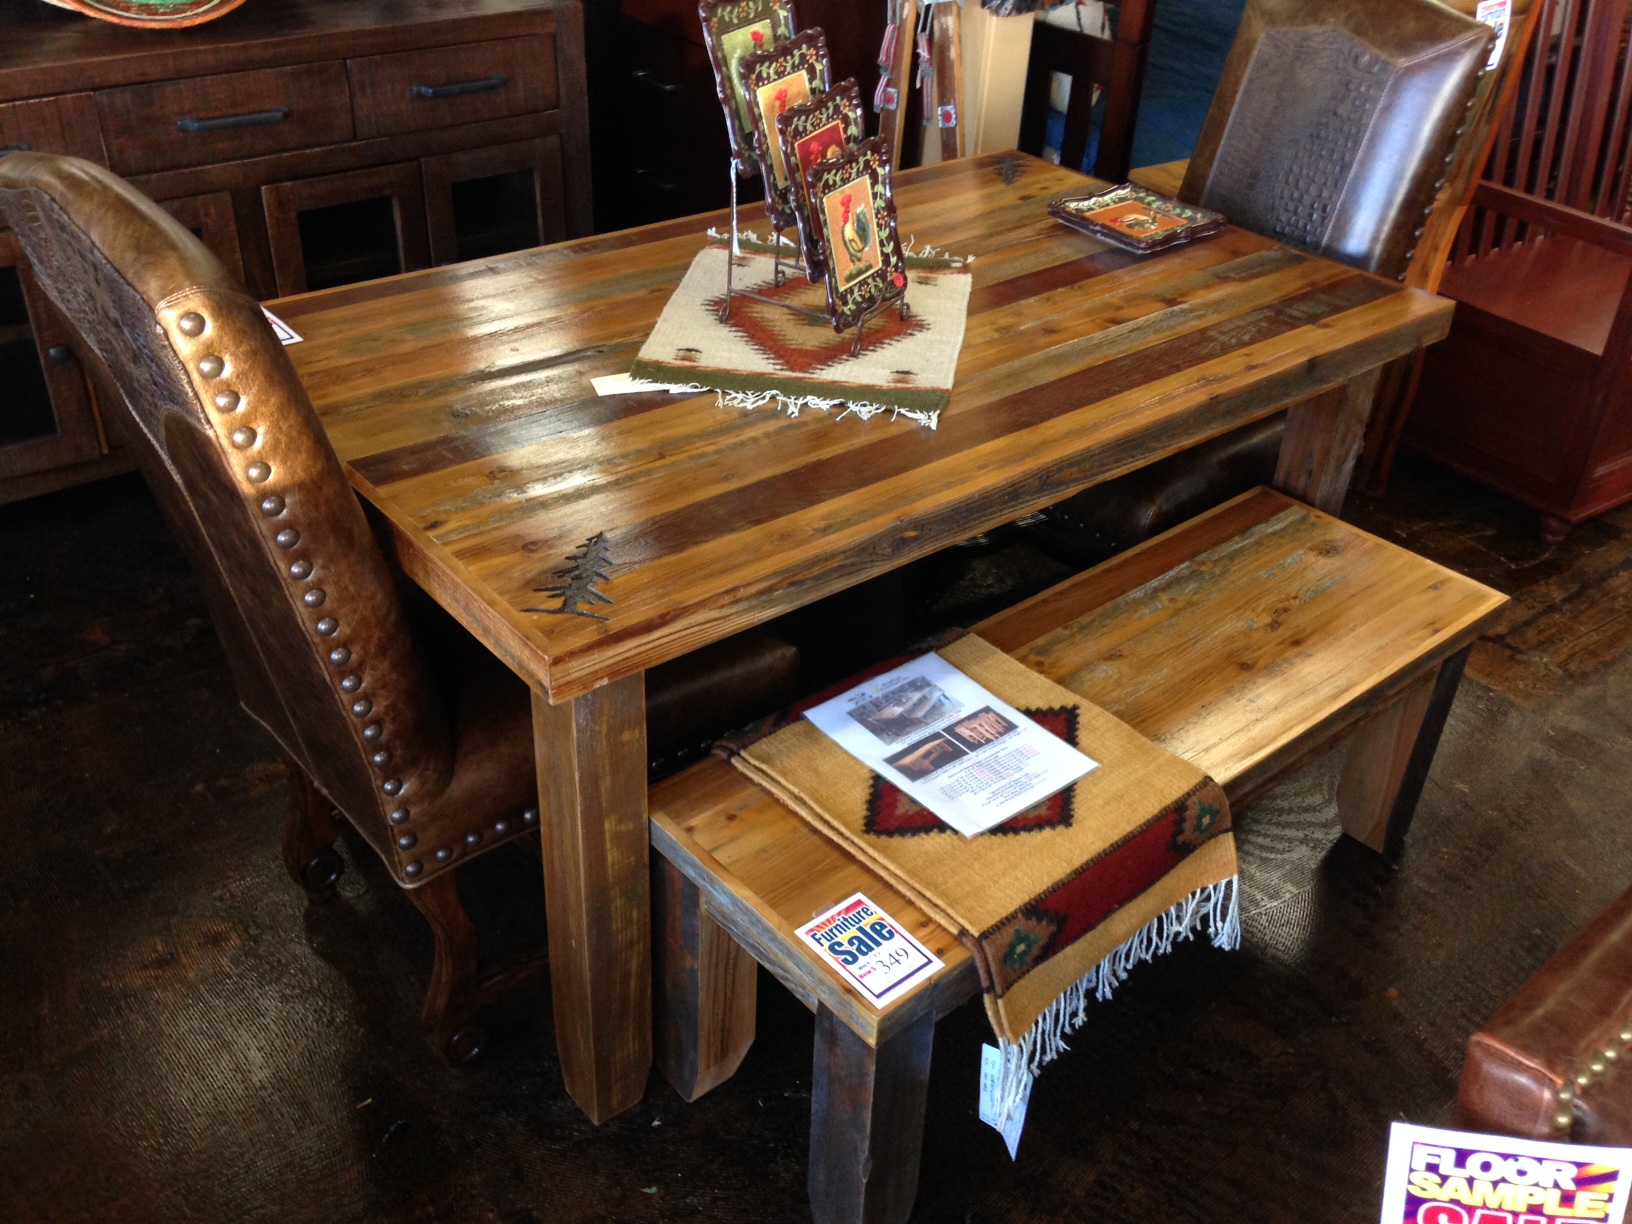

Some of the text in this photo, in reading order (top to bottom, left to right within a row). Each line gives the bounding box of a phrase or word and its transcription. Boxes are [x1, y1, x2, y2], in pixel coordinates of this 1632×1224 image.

[810, 906, 874, 947] Furniture
[828, 921, 895, 966] Sale
[858, 970, 872, 979] Now
[875, 947, 909, 974] 349
[1411, 1143, 1578, 1190] FLOOR
[1408, 1170, 1611, 1219] SAMPLE
